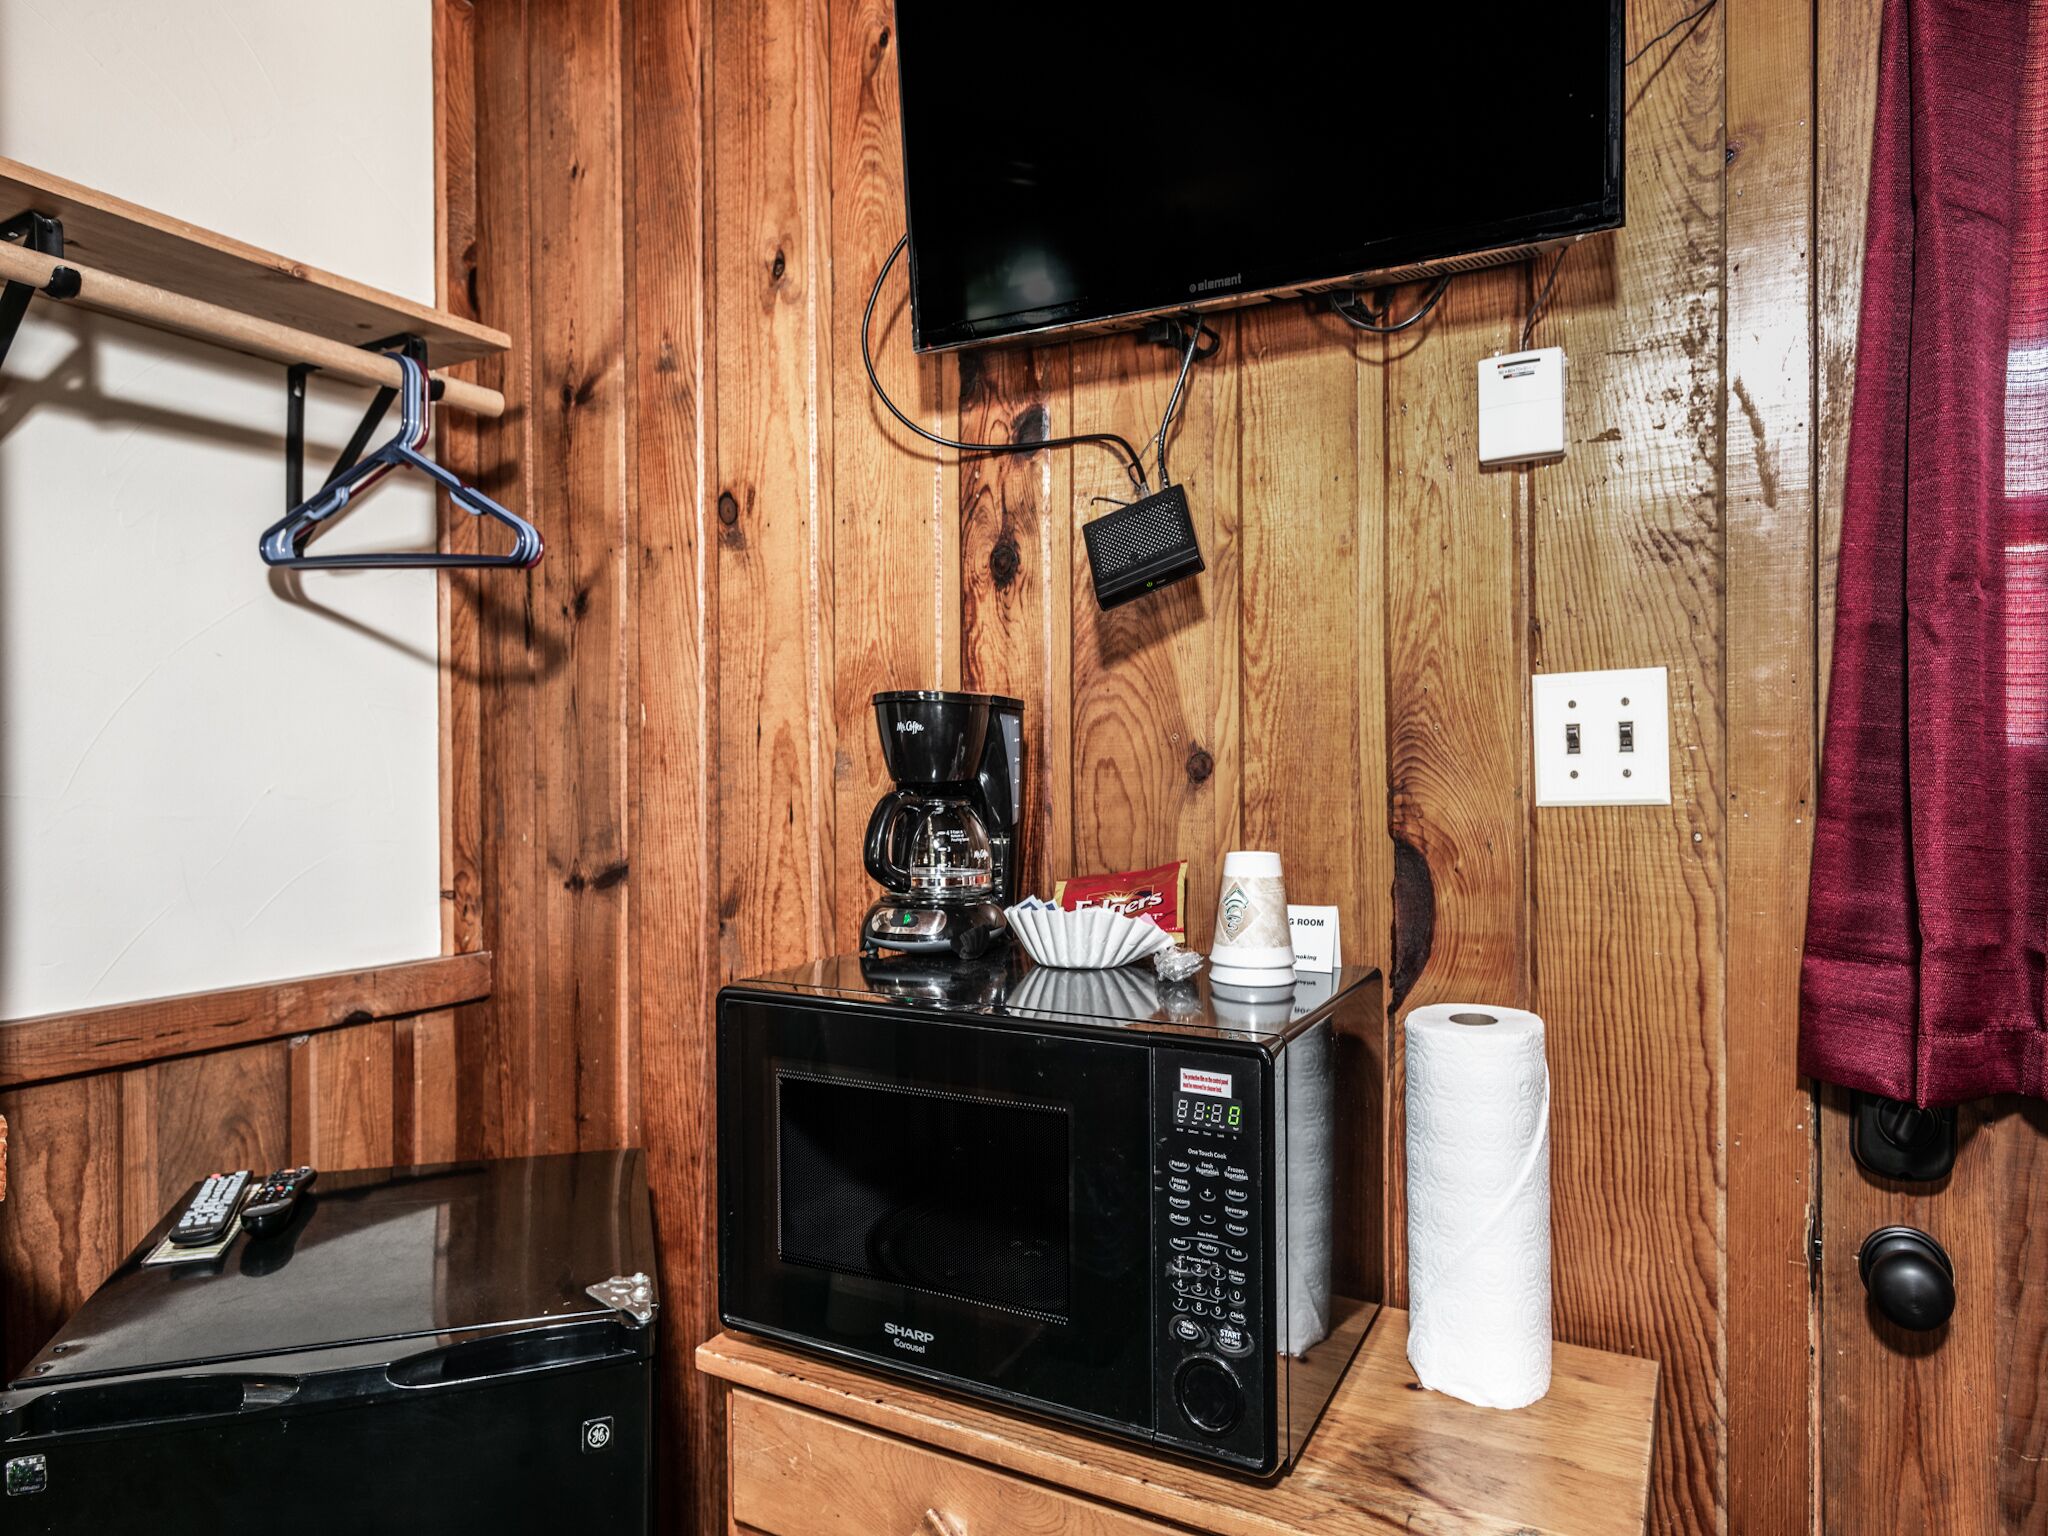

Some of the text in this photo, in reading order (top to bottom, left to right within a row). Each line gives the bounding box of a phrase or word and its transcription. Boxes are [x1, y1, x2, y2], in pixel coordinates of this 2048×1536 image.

[1198, 273, 1241, 291] element
[1297, 918, 1325, 927] ROOM
[1214, 1152, 1227, 1160] Cook
[1171, 1160, 1188, 1168] Potato
[1201, 1161, 1214, 1169] Fresh
[1195, 1166, 1220, 1176] Vegetables
[1227, 1165, 1245, 1174] Frozen
[1223, 1171, 1248, 1180] Vegetables
[1171, 1176, 1188, 1184] Frozen
[1228, 1188, 1244, 1197] Reheat
[1169, 1196, 1190, 1204] Popcorn
[1224, 1205, 1248, 1216] Beverage
[1170, 1213, 1189, 1221] Defrost
[1228, 1223, 1245, 1231] Power
[1198, 1242, 1217, 1252] Poultry
[1231, 1248, 1242, 1256] Fish
[1228, 1269, 1245, 1277] Kitchen
[1230, 1311, 1245, 1319] Clock
[884, 1322, 935, 1343] SHARP
[1181, 1327, 1194, 1335] Clear
[1220, 1329, 1241, 1340] START
[893, 1338, 926, 1354] Carousel
